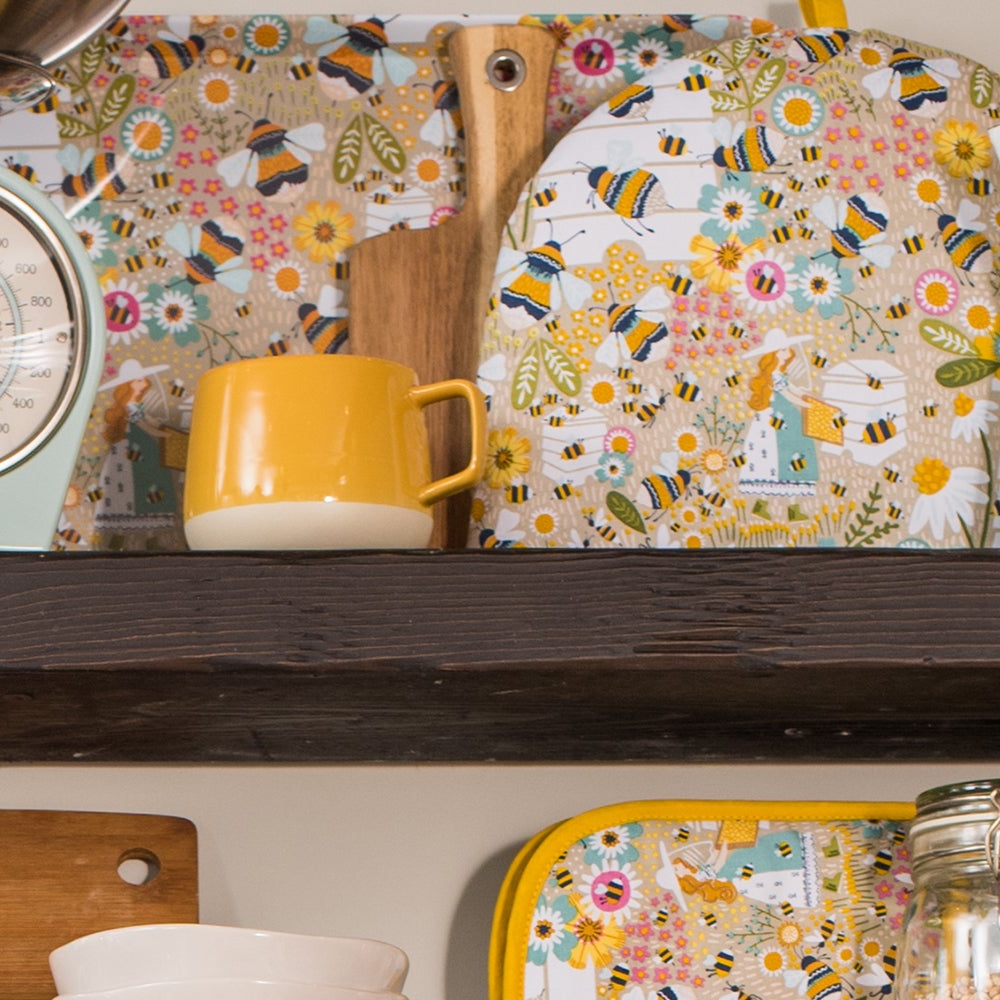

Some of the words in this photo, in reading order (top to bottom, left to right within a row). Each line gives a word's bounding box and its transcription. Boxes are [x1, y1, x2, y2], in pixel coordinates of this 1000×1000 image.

[15, 264, 37, 275] 600
[30, 296, 52, 307] 800
[12, 398, 34, 409] 400
